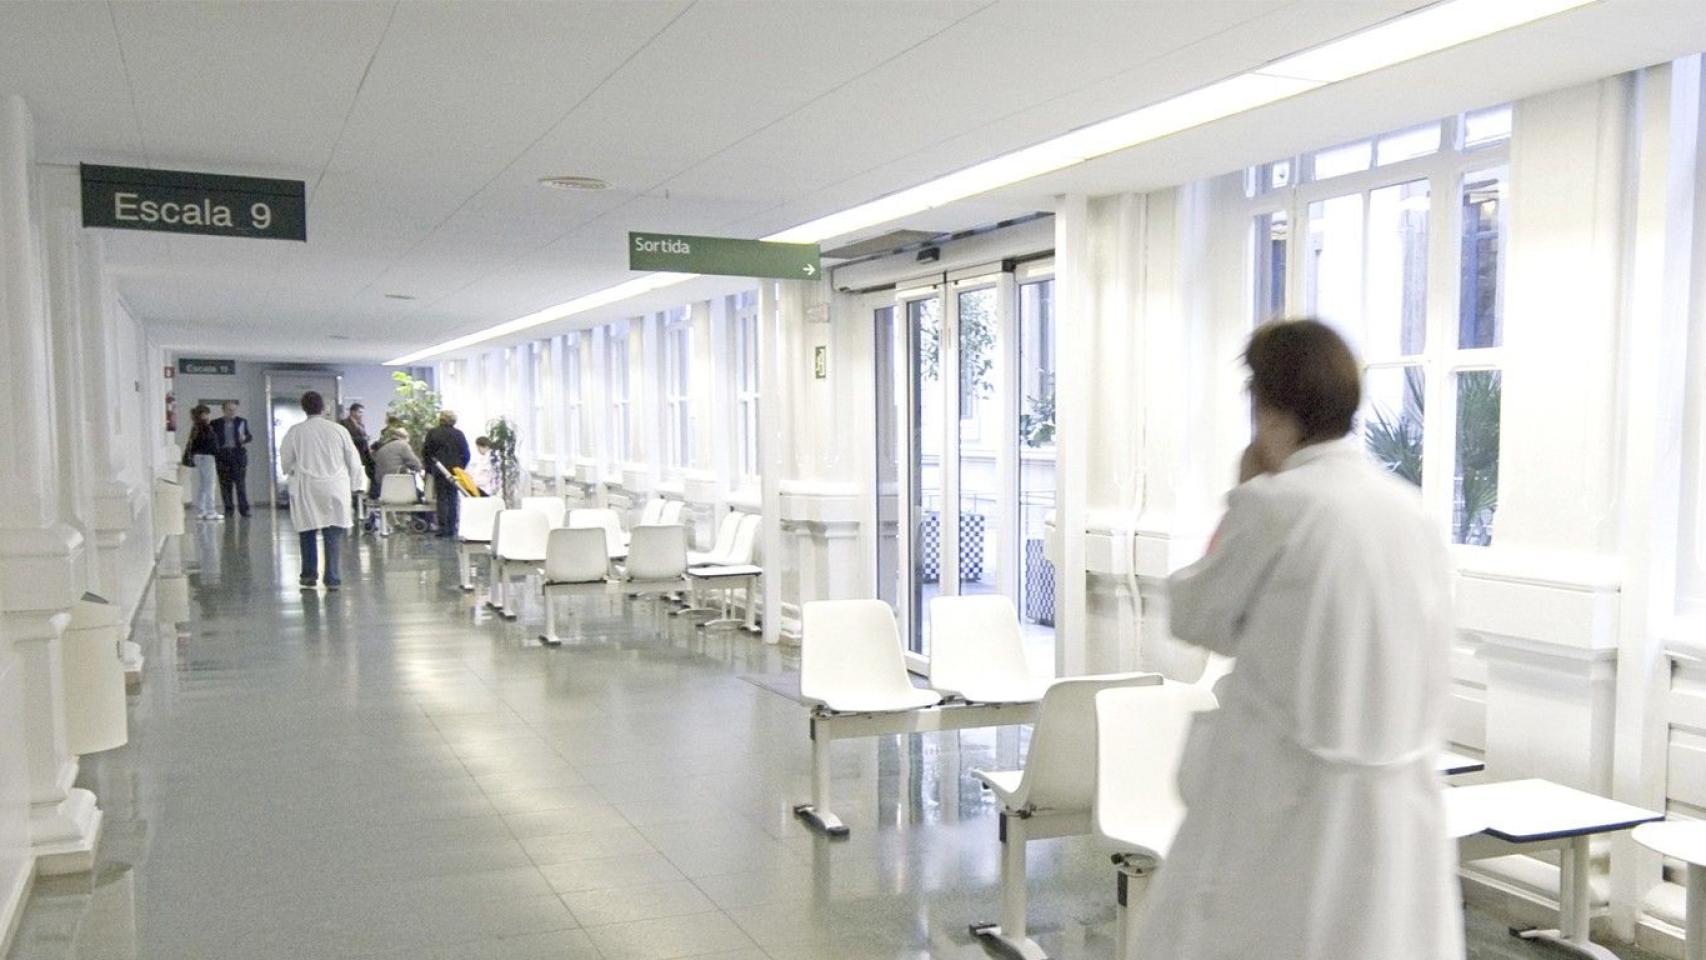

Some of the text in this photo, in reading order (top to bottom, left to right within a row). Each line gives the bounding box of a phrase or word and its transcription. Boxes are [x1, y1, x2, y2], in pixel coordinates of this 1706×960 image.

[114, 192, 271, 229] Escala 9
[635, 237, 690, 254] Sortida
